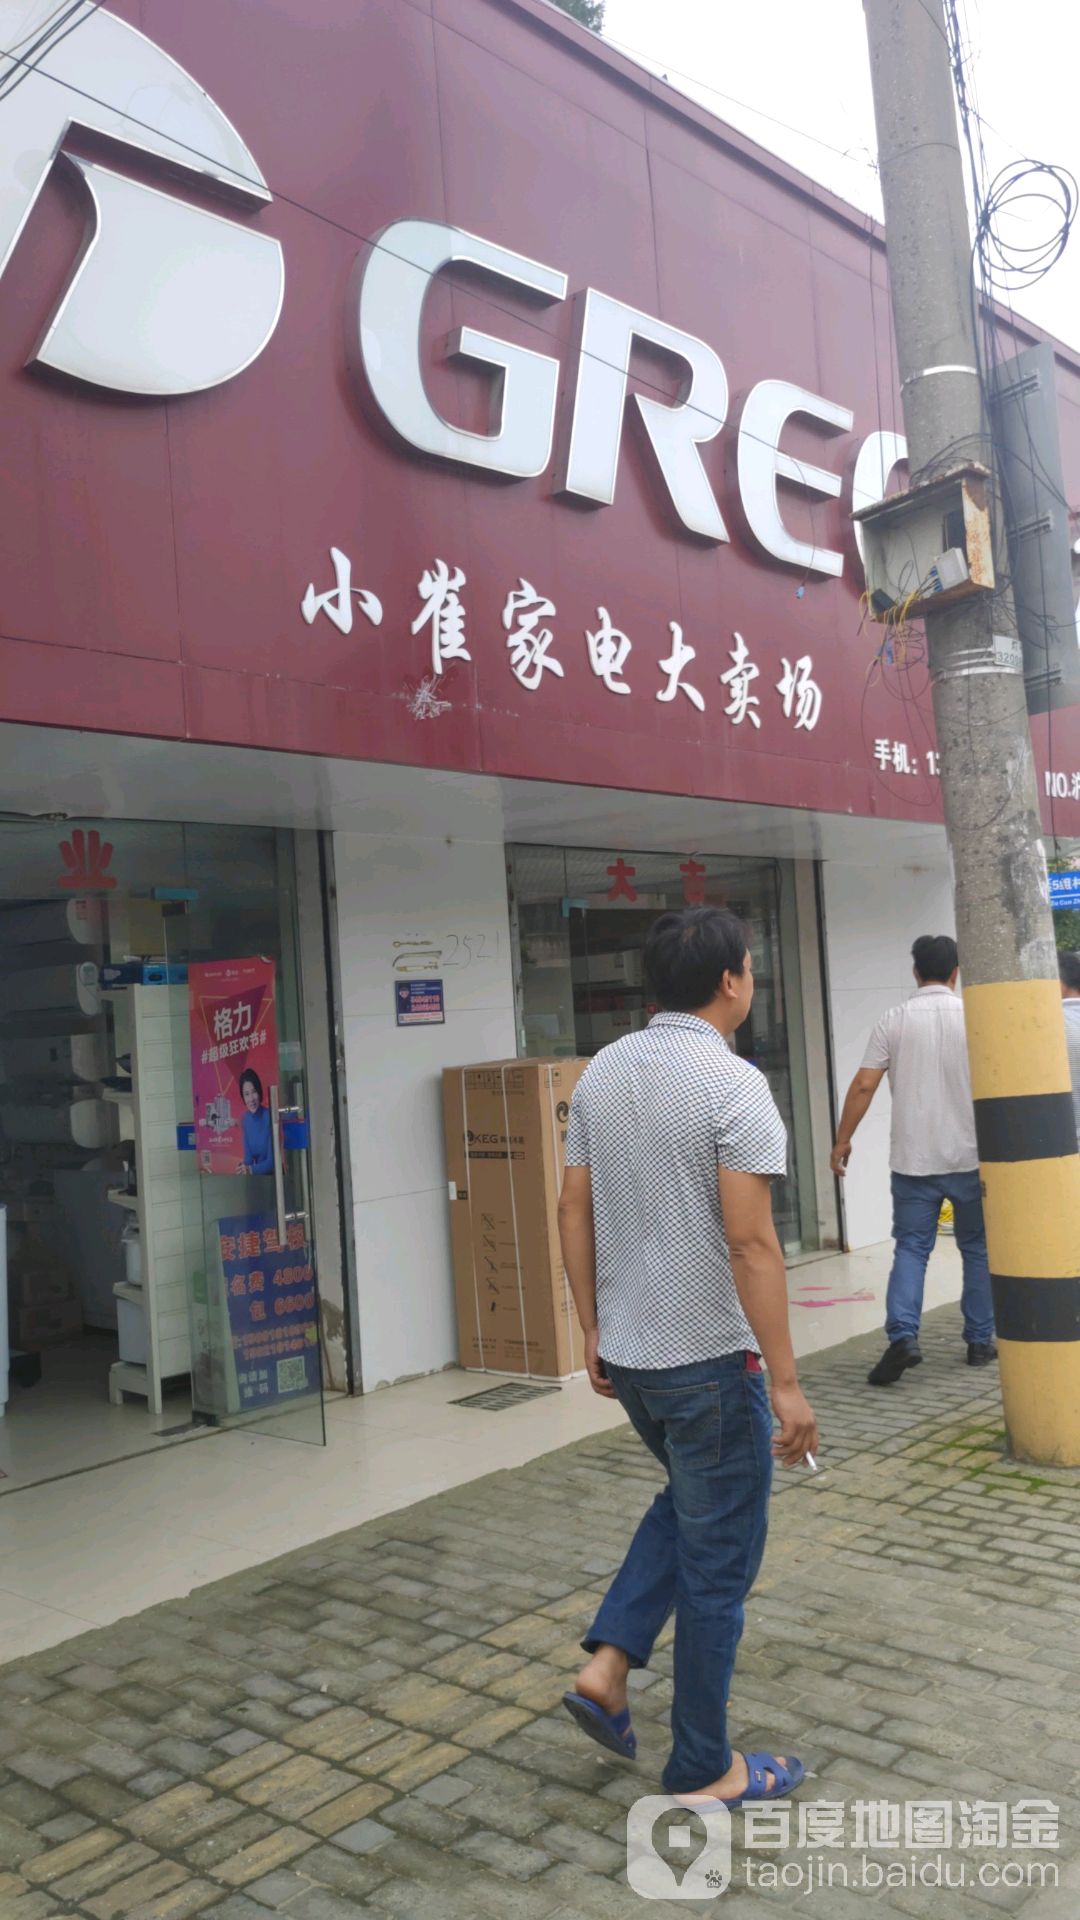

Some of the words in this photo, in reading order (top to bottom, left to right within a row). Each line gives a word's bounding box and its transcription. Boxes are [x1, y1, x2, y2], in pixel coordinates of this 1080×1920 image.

[359, 217, 908, 577] GRE
[302, 547, 822, 731] 小崔家电大卖场
[213, 1001, 252, 1041] 格力
[223, 1269, 265, 1298] 名费
